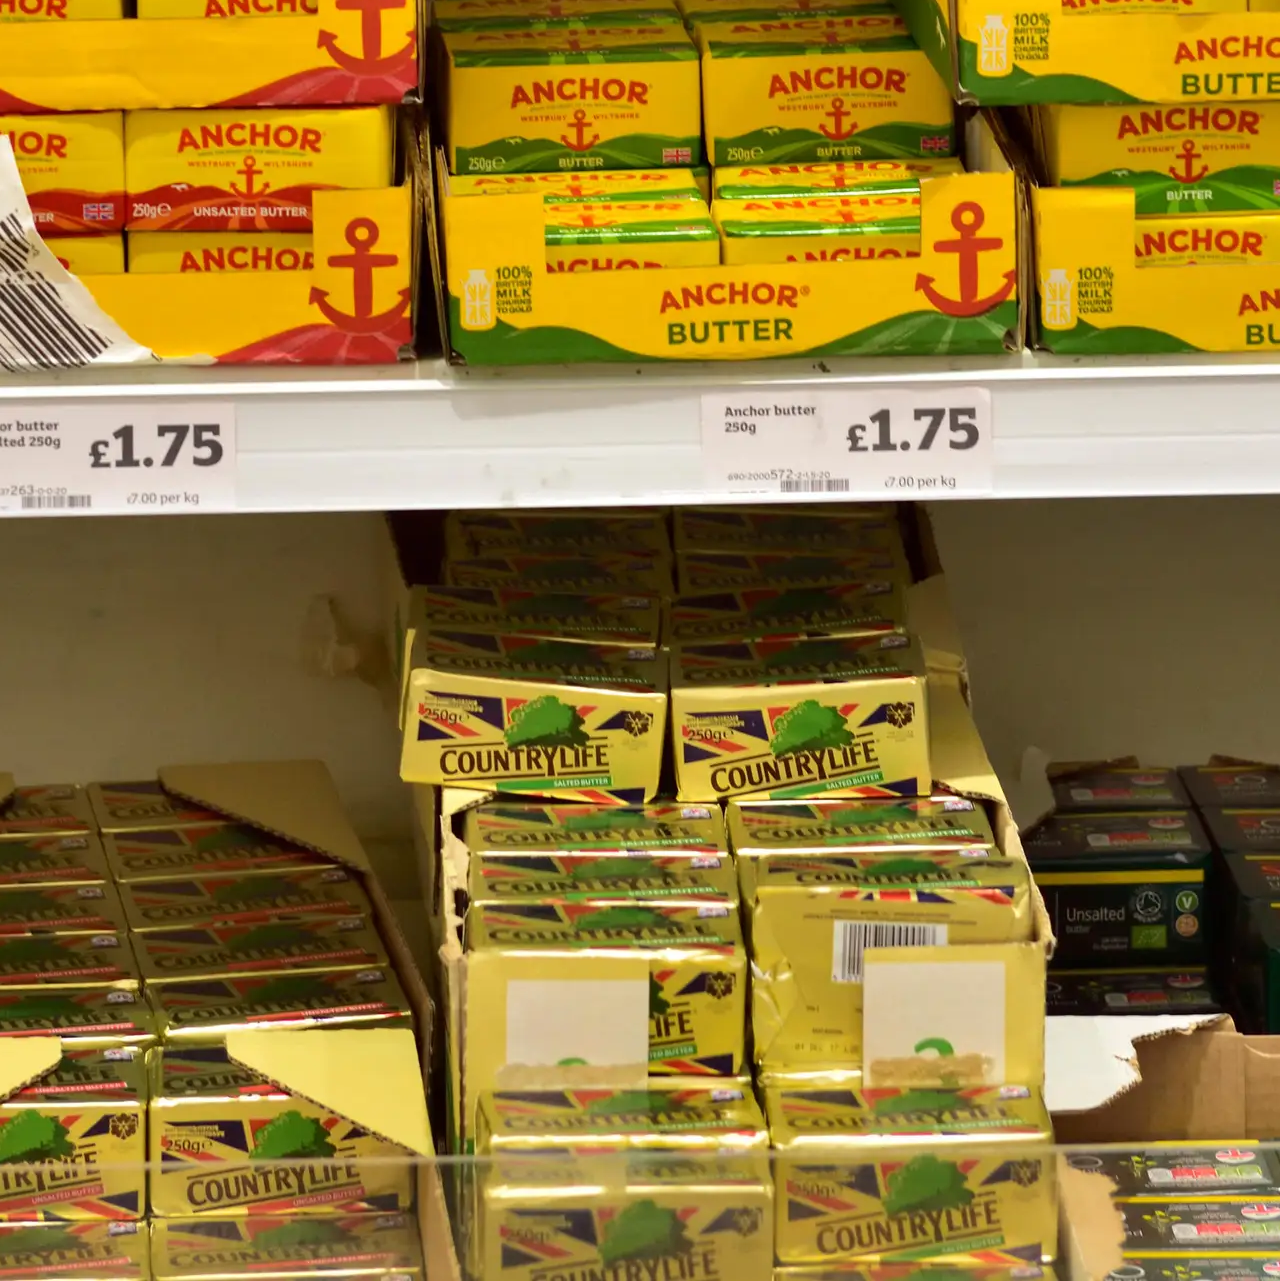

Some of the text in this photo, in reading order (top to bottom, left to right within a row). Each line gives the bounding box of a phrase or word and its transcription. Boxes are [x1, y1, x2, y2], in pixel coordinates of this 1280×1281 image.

[511, 78, 648, 108] ANCHOR
[558, 157, 604, 167] BUTTER
[194, 206, 306, 217] UNSALTED BUTTER
[667, 318, 792, 346] BUTTER
[725, 405, 816, 417] Anchor butter
[16, 421, 59, 431] butter
[725, 422, 756, 434] 250g
[847, 408, 979, 451] £1.75
[29, 437, 61, 449] 250g
[89, 424, 223, 468] £1.75
[160, 494, 180, 506] per
[184, 492, 199, 504] kg
[553, 777, 608, 787] SALTED BUTTER
